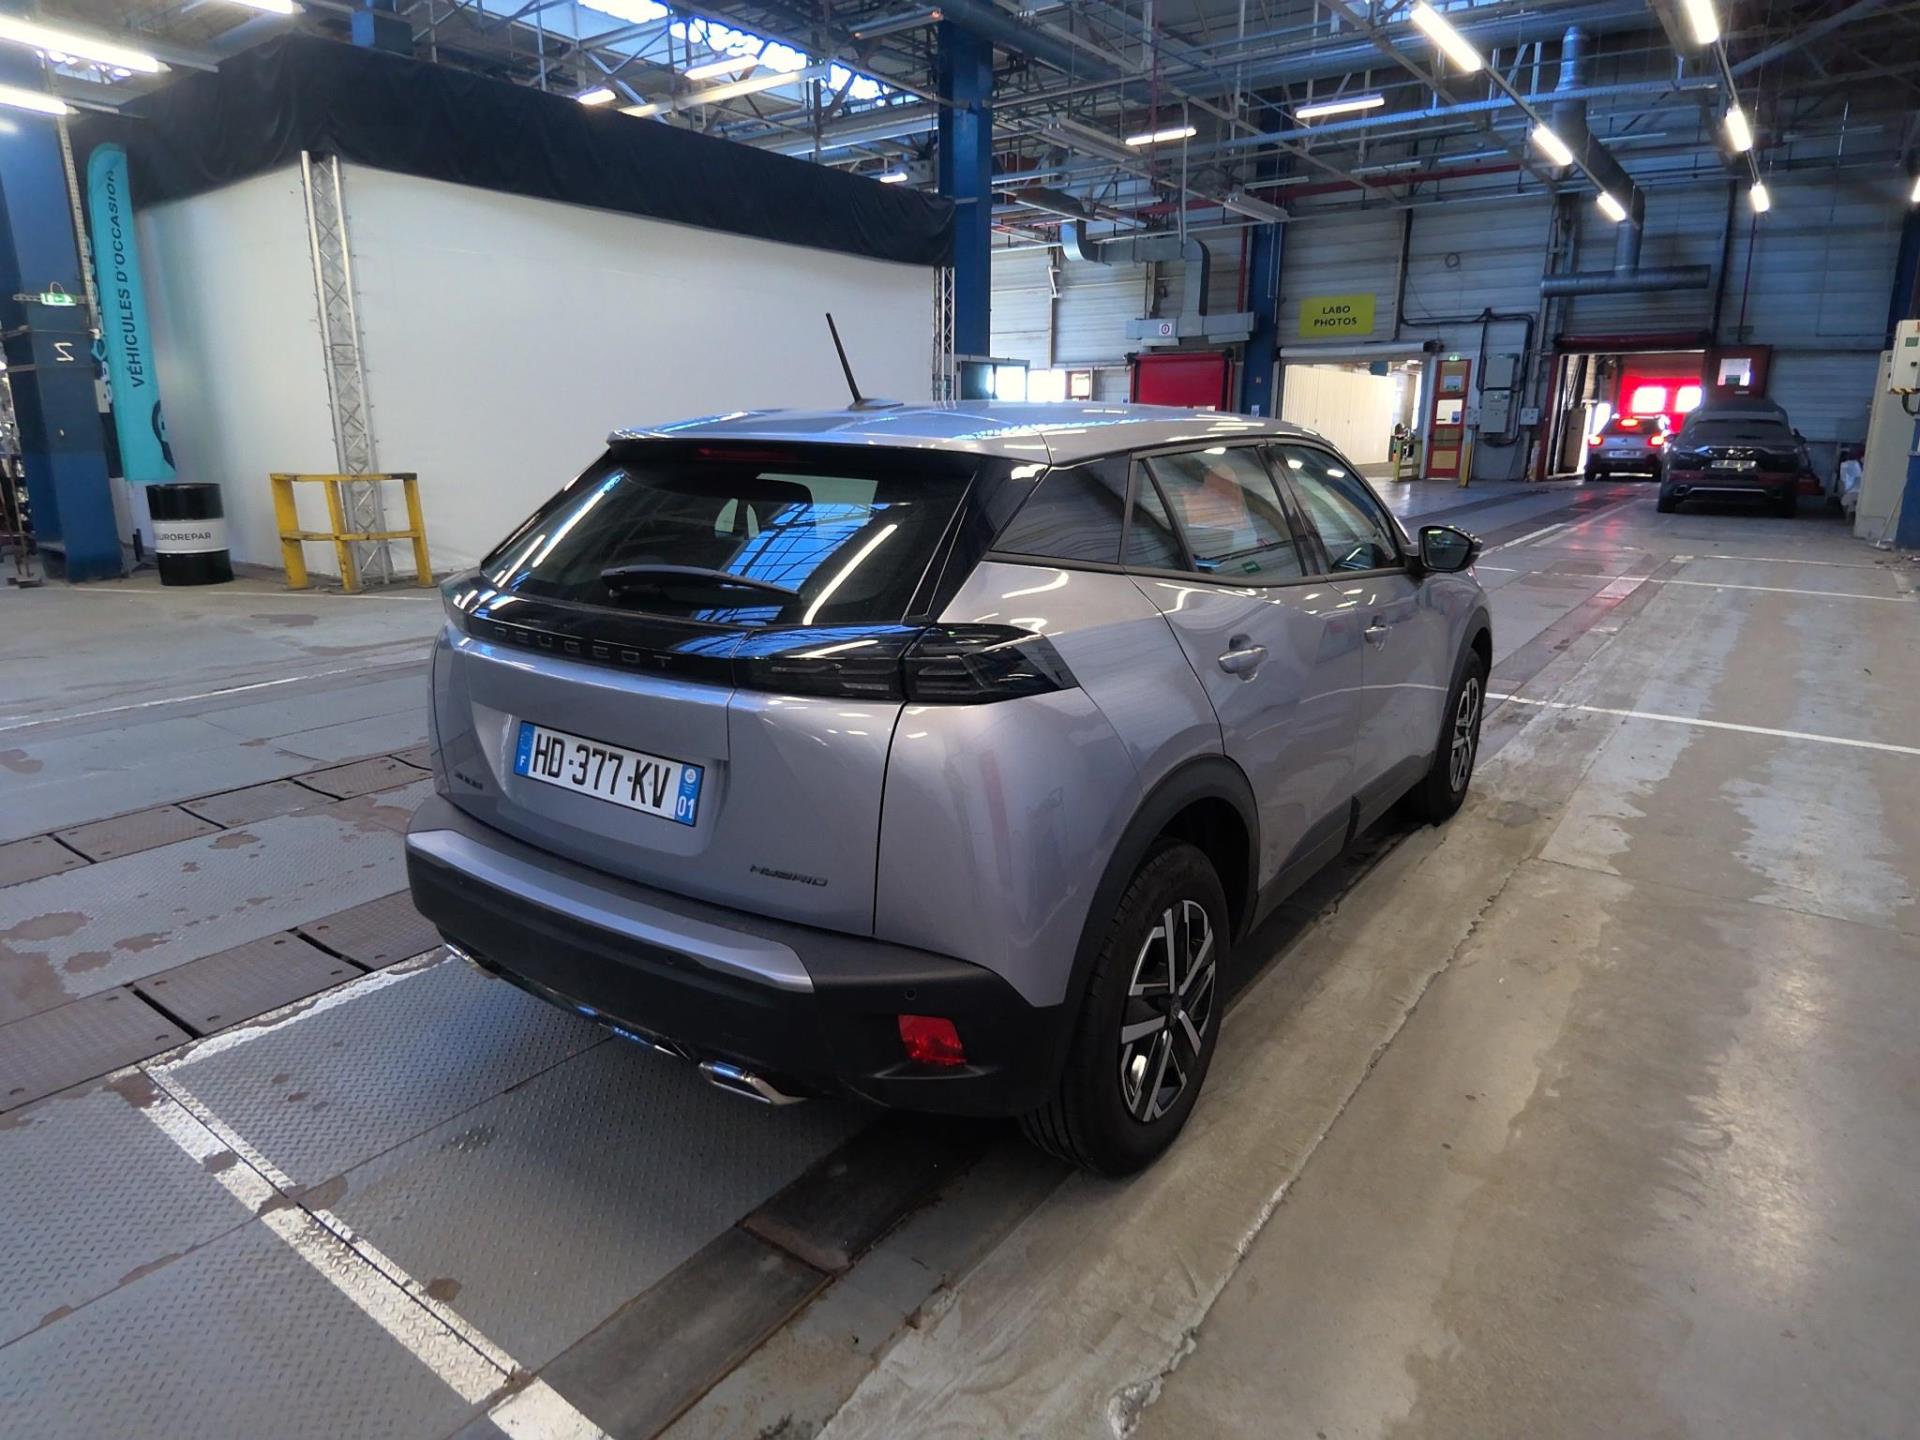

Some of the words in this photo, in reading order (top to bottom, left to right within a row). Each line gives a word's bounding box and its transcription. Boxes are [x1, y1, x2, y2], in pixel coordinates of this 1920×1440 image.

[1322, 304, 1352, 315] LABO
[1313, 316, 1358, 328] PHOTOS
[118, 289, 146, 389] VÉHICULES
[155, 531, 212, 542] UROREPAR
[494, 626, 673, 668] PEUGEOT
[677, 795, 697, 820] 01
